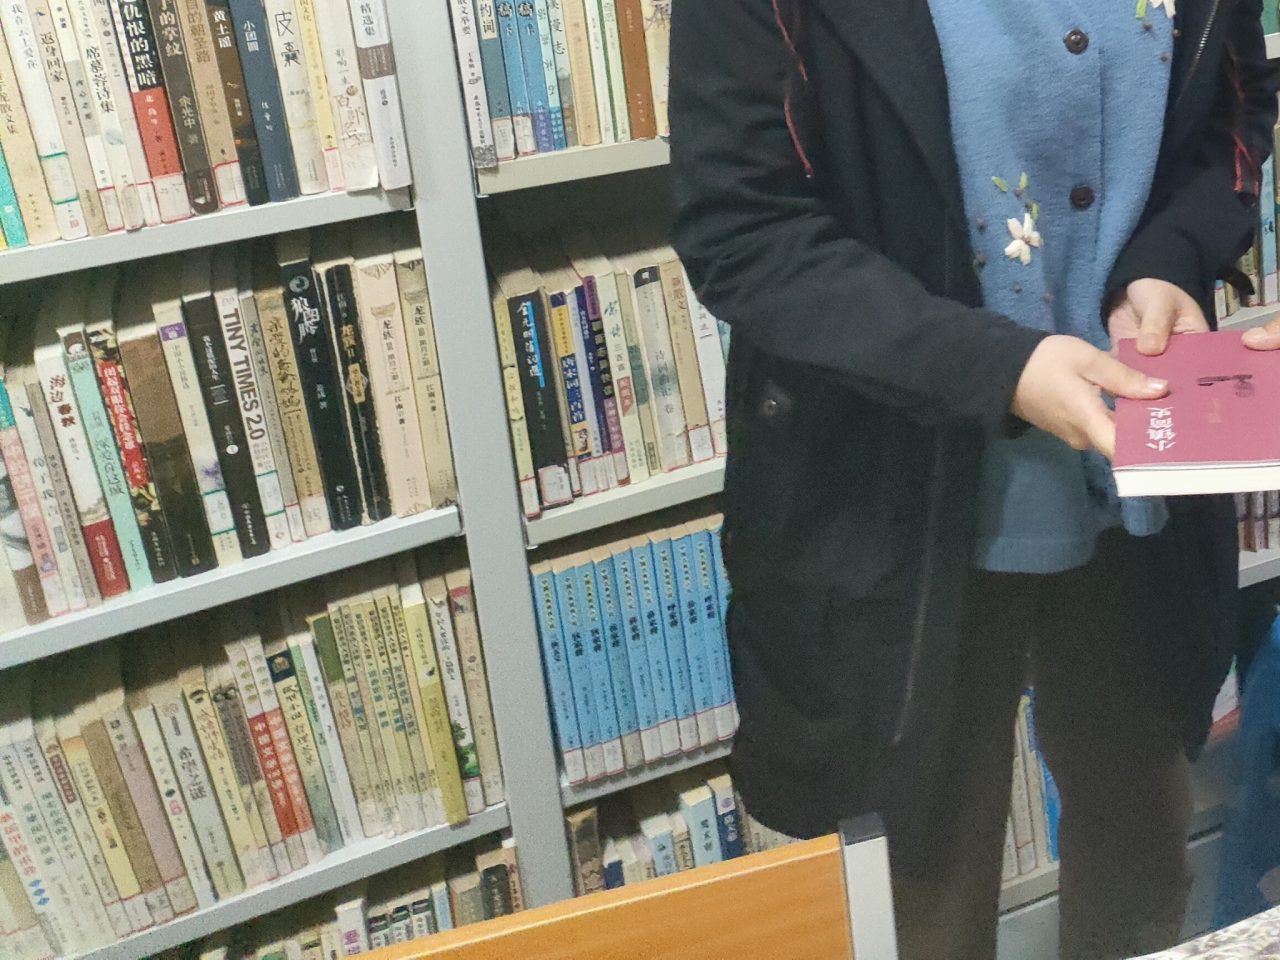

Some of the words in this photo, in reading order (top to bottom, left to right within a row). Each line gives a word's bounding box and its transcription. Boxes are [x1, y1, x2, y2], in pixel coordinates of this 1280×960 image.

[274, 9, 302, 68] 皮囊
[222, 308, 246, 357] TINY
[233, 358, 260, 412] TIMES
[247, 414, 266, 441] 2.0
